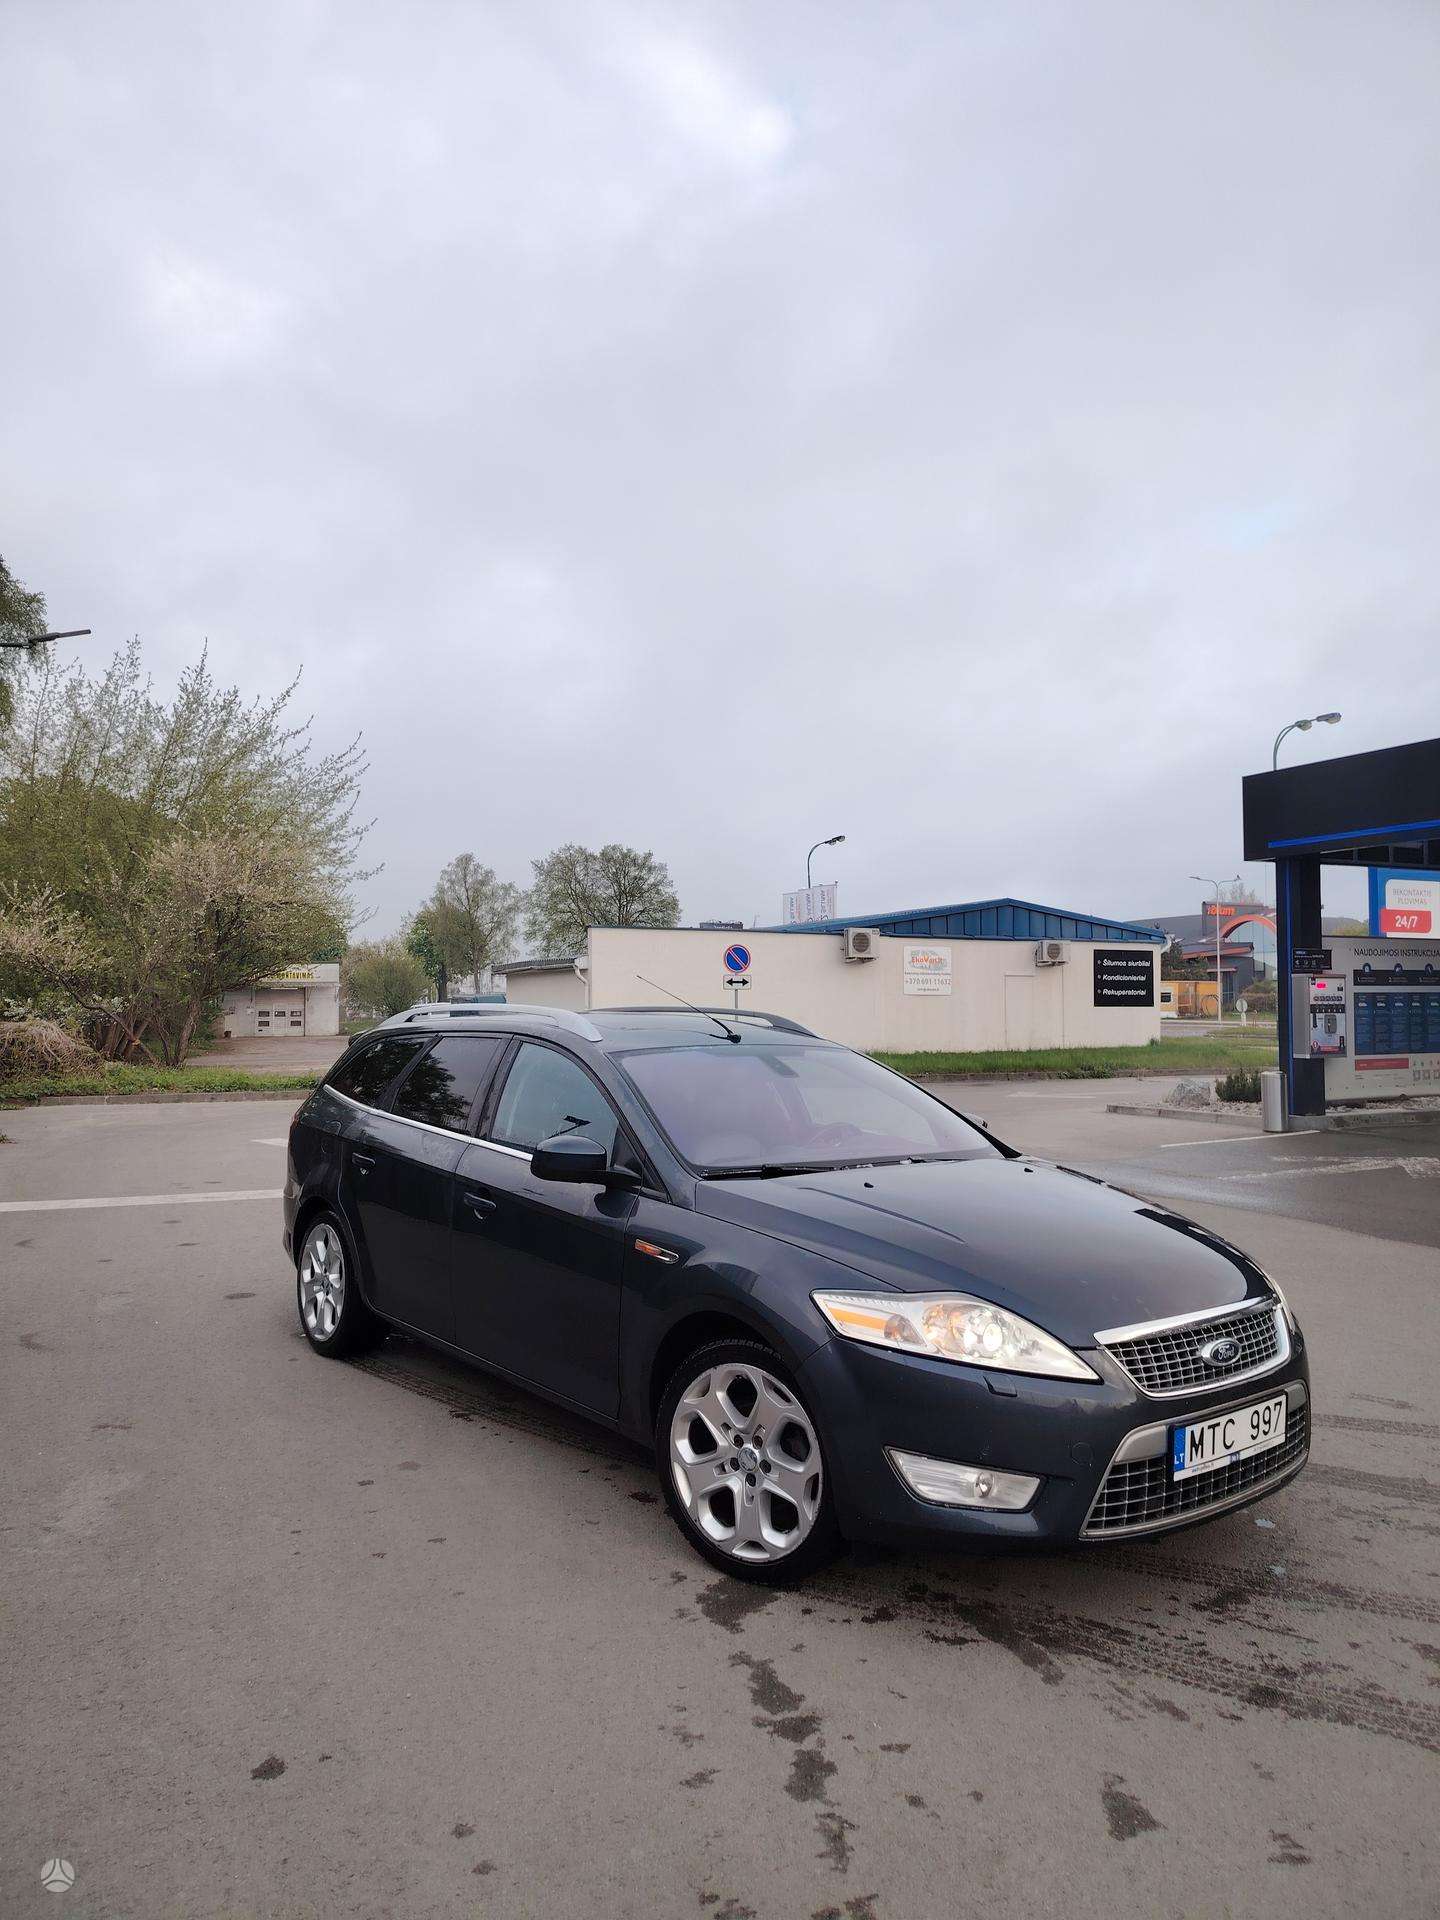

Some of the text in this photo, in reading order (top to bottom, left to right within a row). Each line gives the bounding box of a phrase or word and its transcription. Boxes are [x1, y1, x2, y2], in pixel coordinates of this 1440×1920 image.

[1394, 914, 1418, 929] 24/7
[1218, 1344, 1235, 1360] Ford
[1174, 1401, 1282, 1465] LT MTC 997
